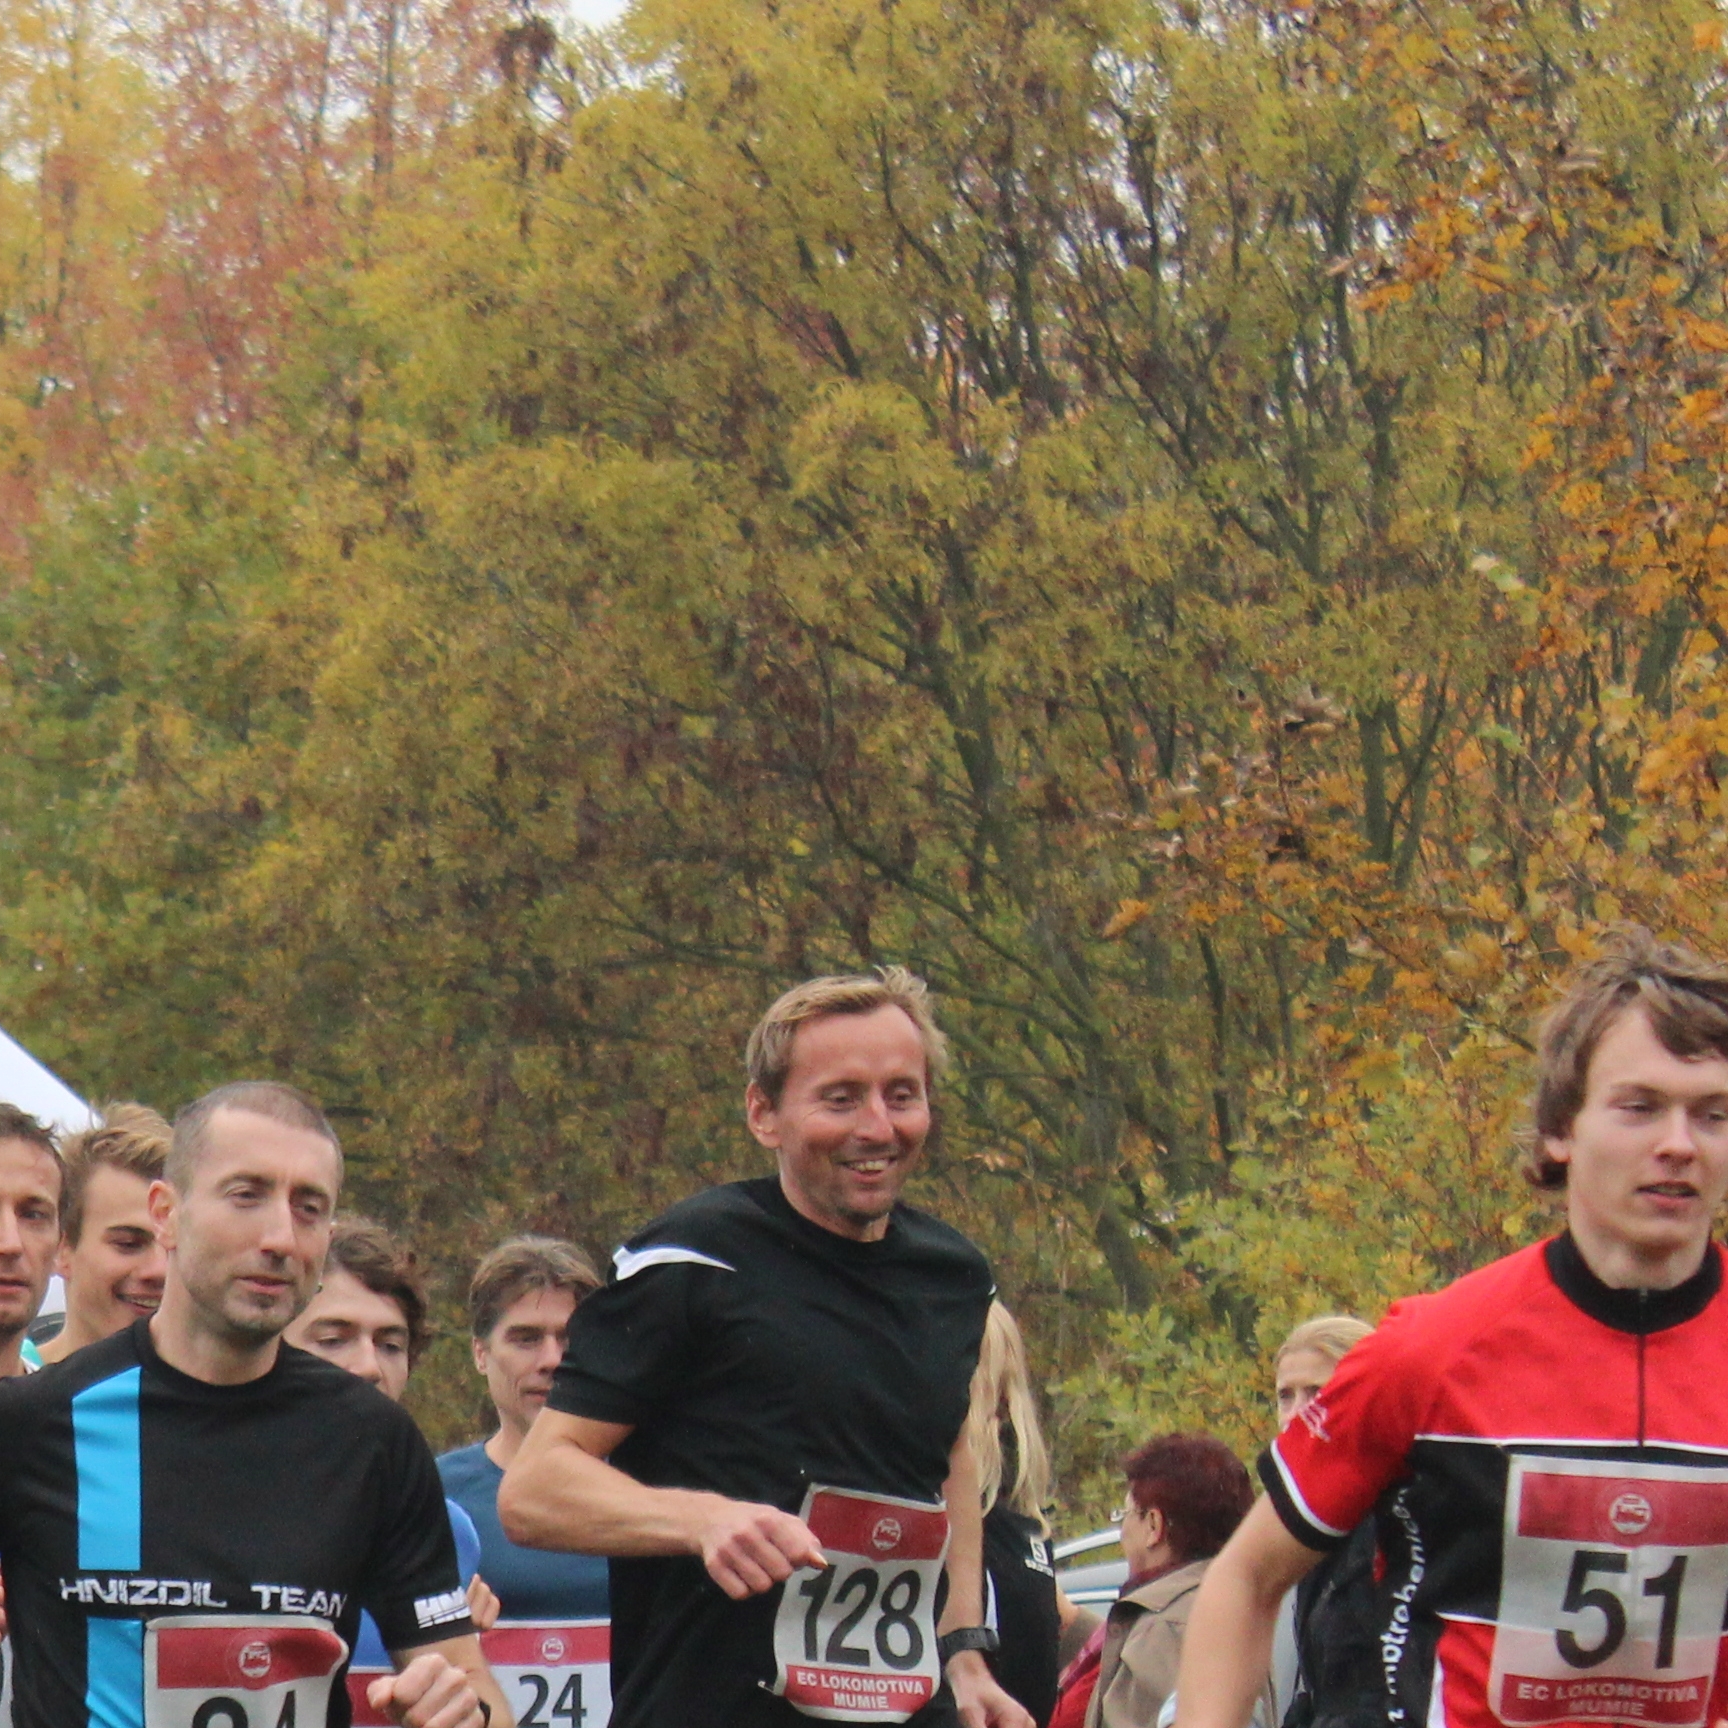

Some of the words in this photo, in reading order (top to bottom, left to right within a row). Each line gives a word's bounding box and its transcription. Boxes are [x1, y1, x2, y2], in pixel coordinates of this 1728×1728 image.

[60, 1577, 228, 1608] HNIZDIL
[250, 1582, 348, 1619] TEAM
[1555, 1549, 1689, 1670] 51
[798, 1563, 925, 1671] 128
[796, 1671, 817, 1686] EC
[821, 1672, 925, 1696] LOKOMOTIVA
[1516, 1683, 1550, 1701] EC
[1555, 1683, 1699, 1704] LOKOMOTIVA
[833, 1692, 889, 1709] MUMIE
